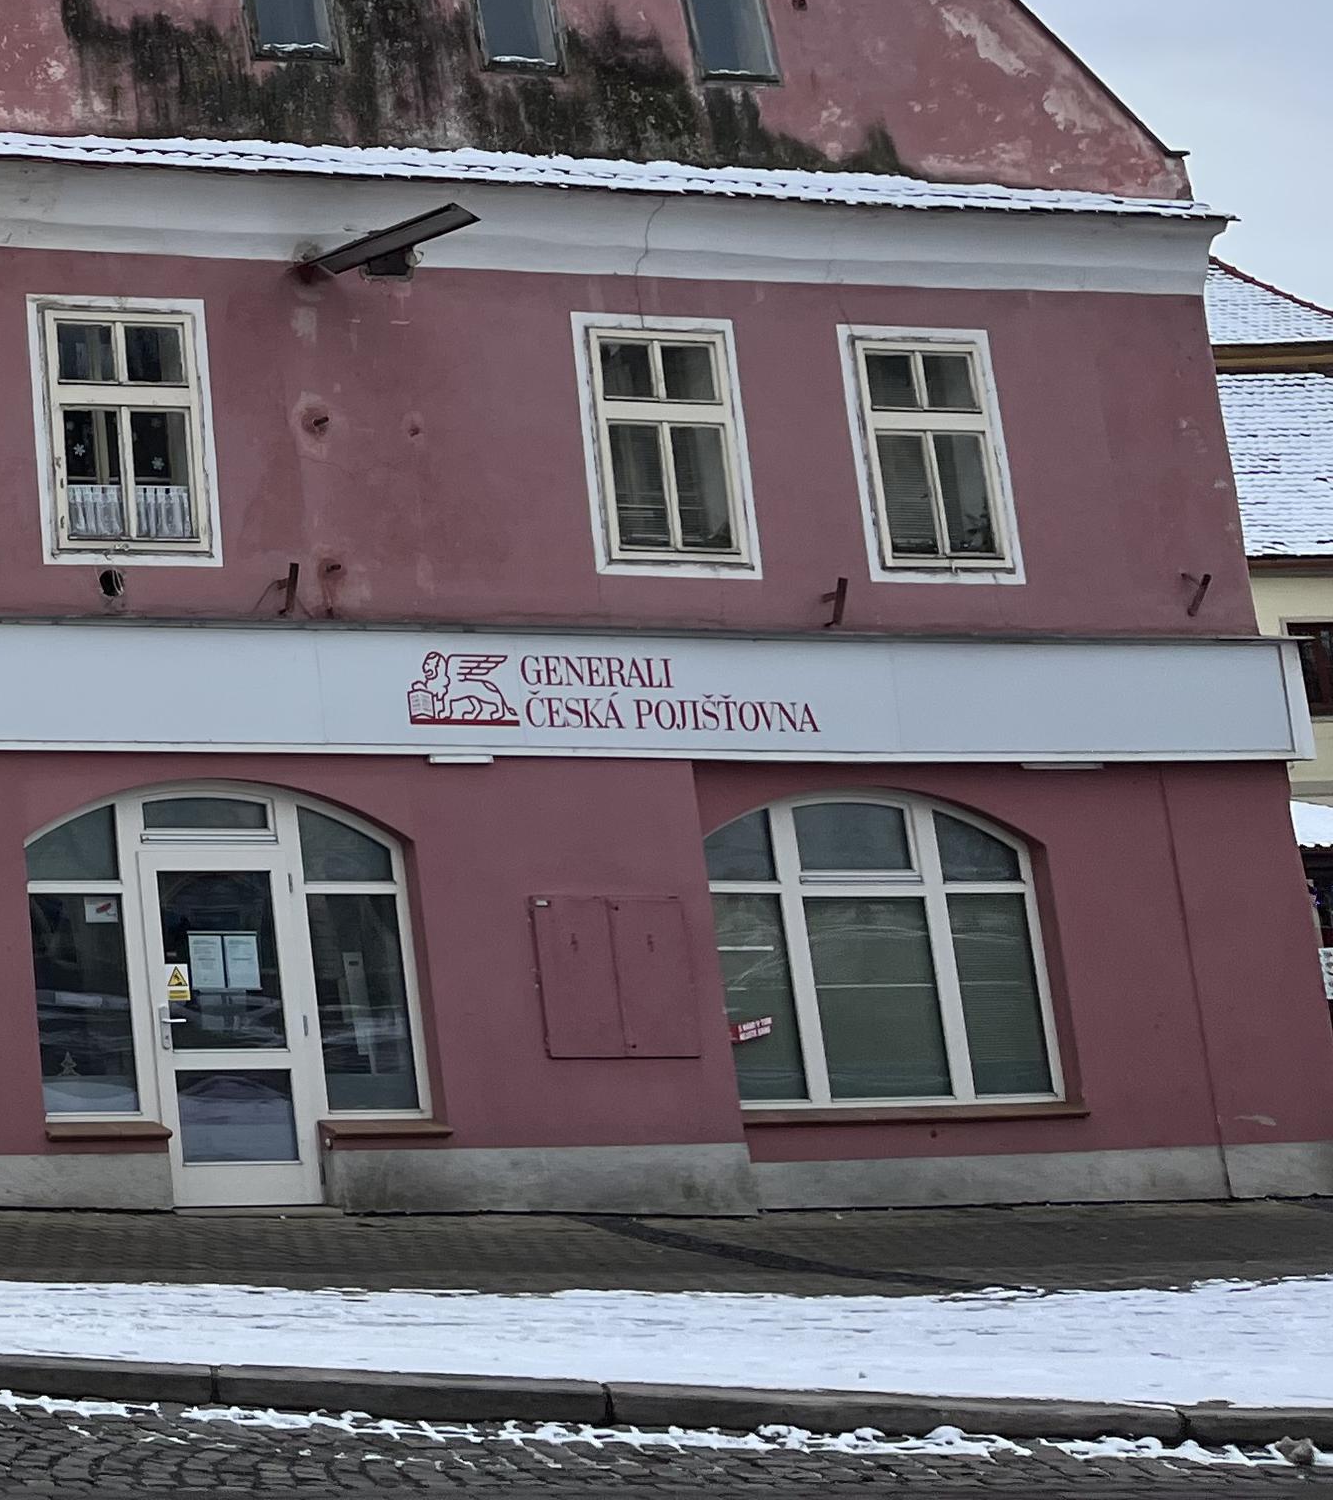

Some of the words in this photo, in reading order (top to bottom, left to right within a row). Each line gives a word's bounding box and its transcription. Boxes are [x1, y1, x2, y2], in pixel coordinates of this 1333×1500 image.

[520, 655, 674, 688] GENERALI
[525, 690, 626, 729] ČESKÁ
[632, 694, 821, 732] POJIŠŤOVNA
